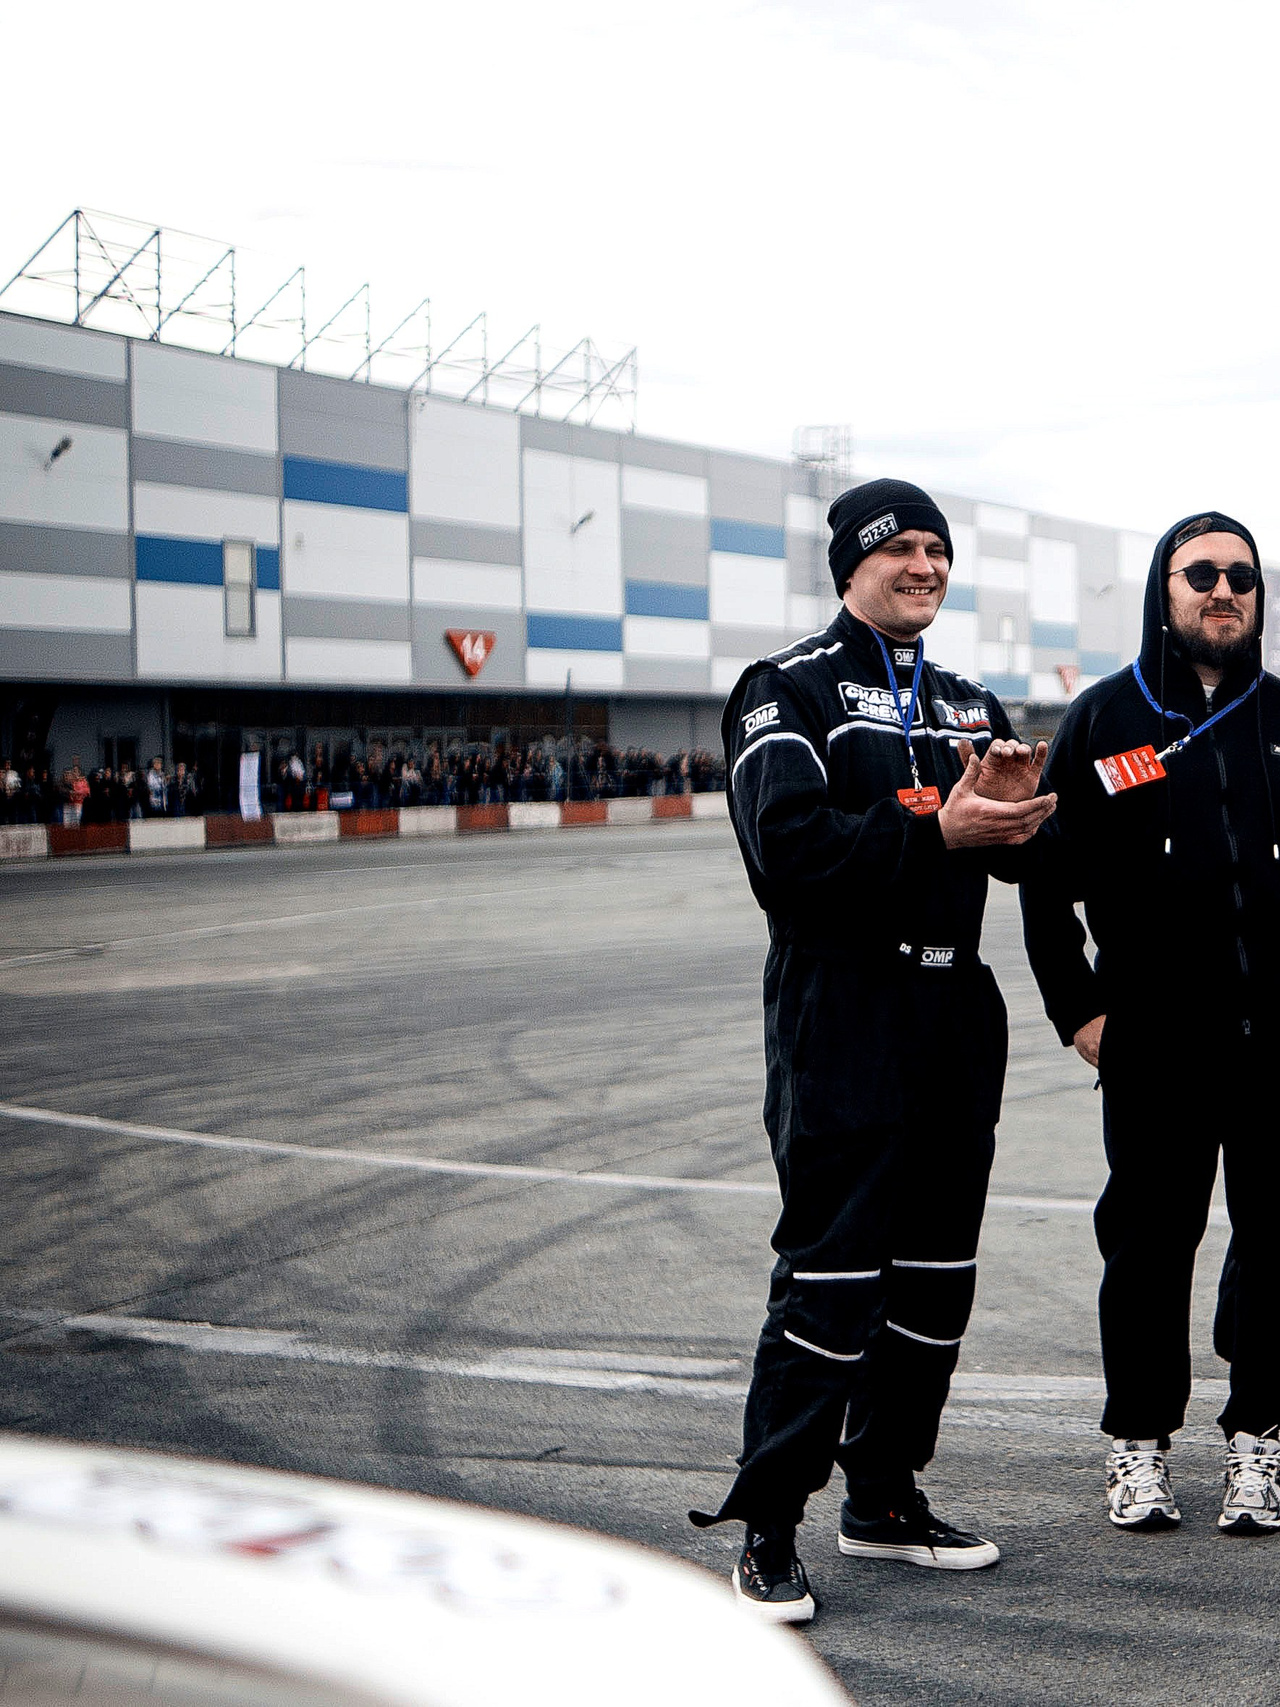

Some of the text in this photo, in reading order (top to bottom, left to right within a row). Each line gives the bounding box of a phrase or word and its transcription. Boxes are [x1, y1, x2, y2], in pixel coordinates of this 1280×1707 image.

[745, 706, 779, 732] OMP
[857, 700, 908, 721] CREW
[922, 950, 954, 963] OMP
